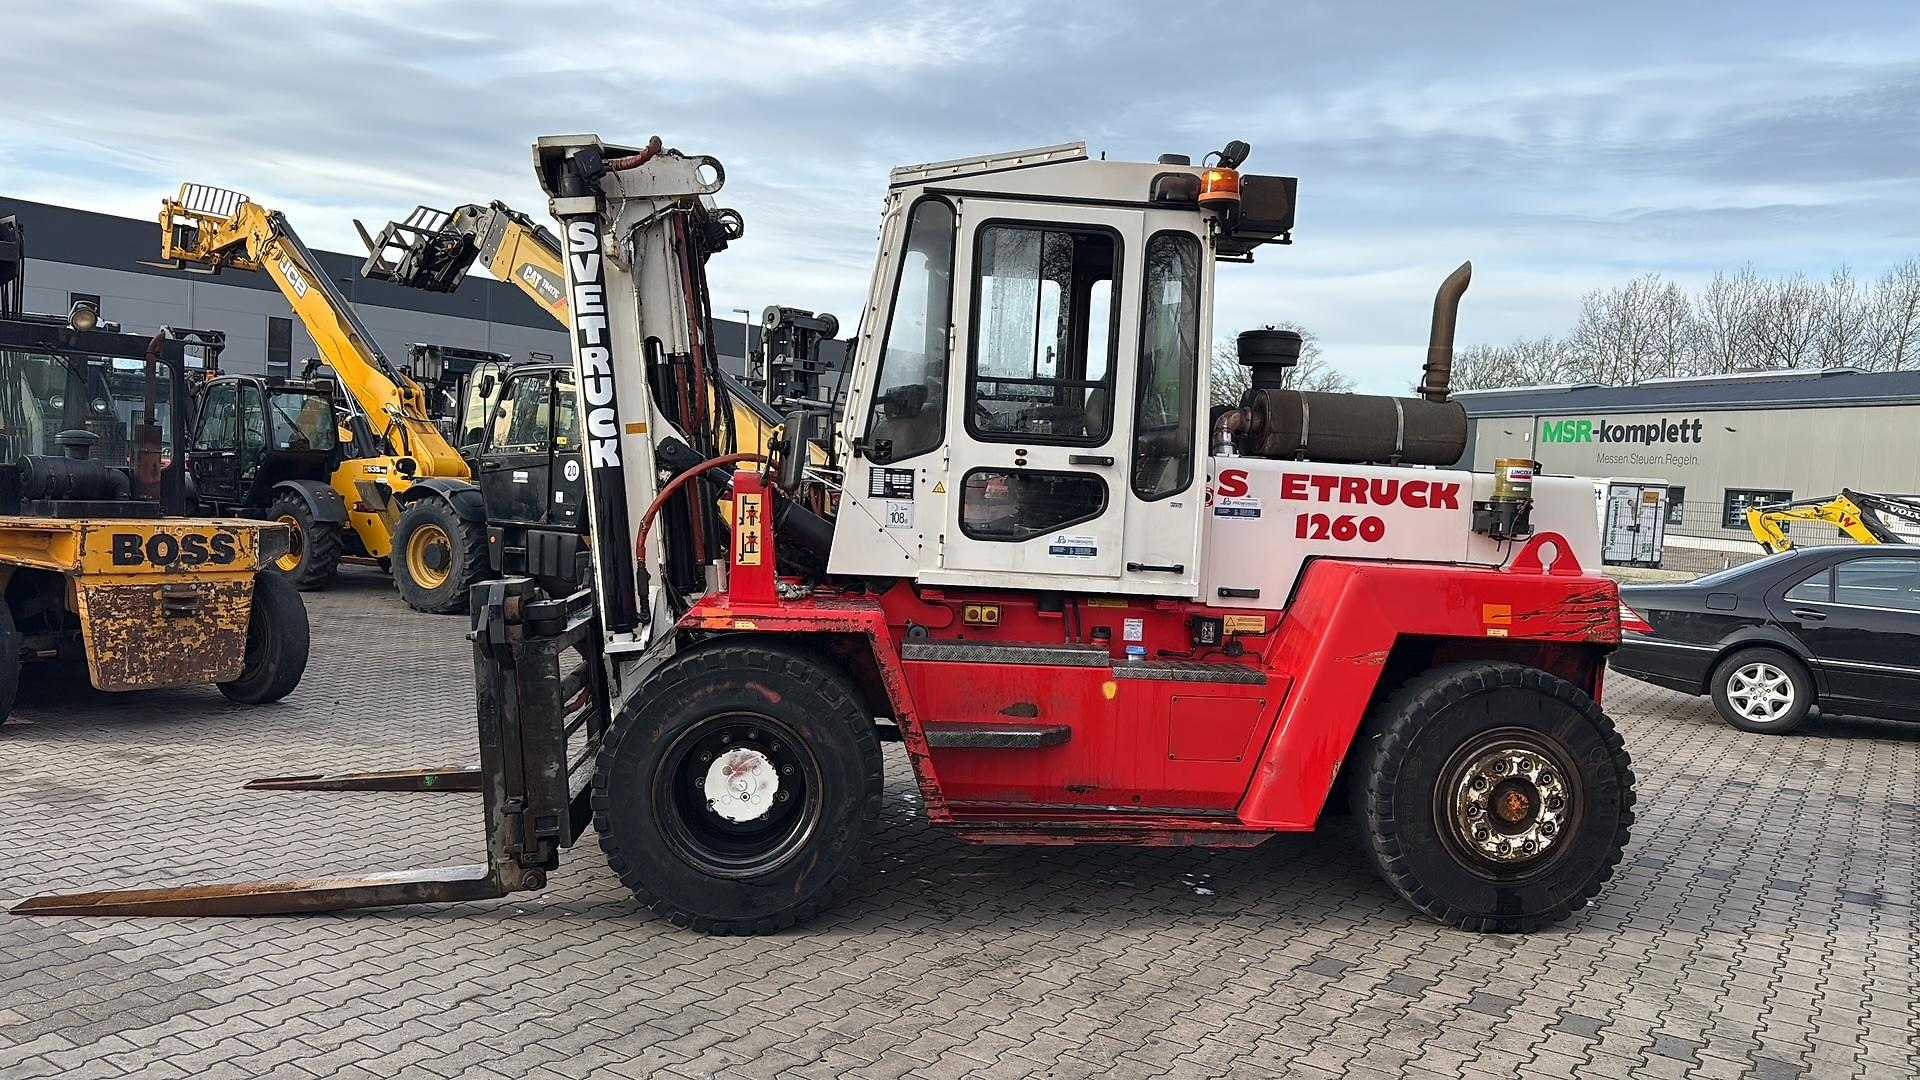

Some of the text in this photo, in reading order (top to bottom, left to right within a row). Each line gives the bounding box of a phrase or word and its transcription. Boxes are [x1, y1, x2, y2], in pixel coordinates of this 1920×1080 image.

[279, 255, 308, 298] JCB
[523, 265, 543, 289] CAT
[568, 221, 621, 469] SVETRUCK
[1542, 418, 1702, 445] MSR-komplett
[567, 465, 577, 477] 20
[1280, 473, 1461, 510] ETRUCK
[890, 512, 905, 524] 108
[1295, 513, 1385, 542] 1260
[112, 533, 236, 566] BOSS
